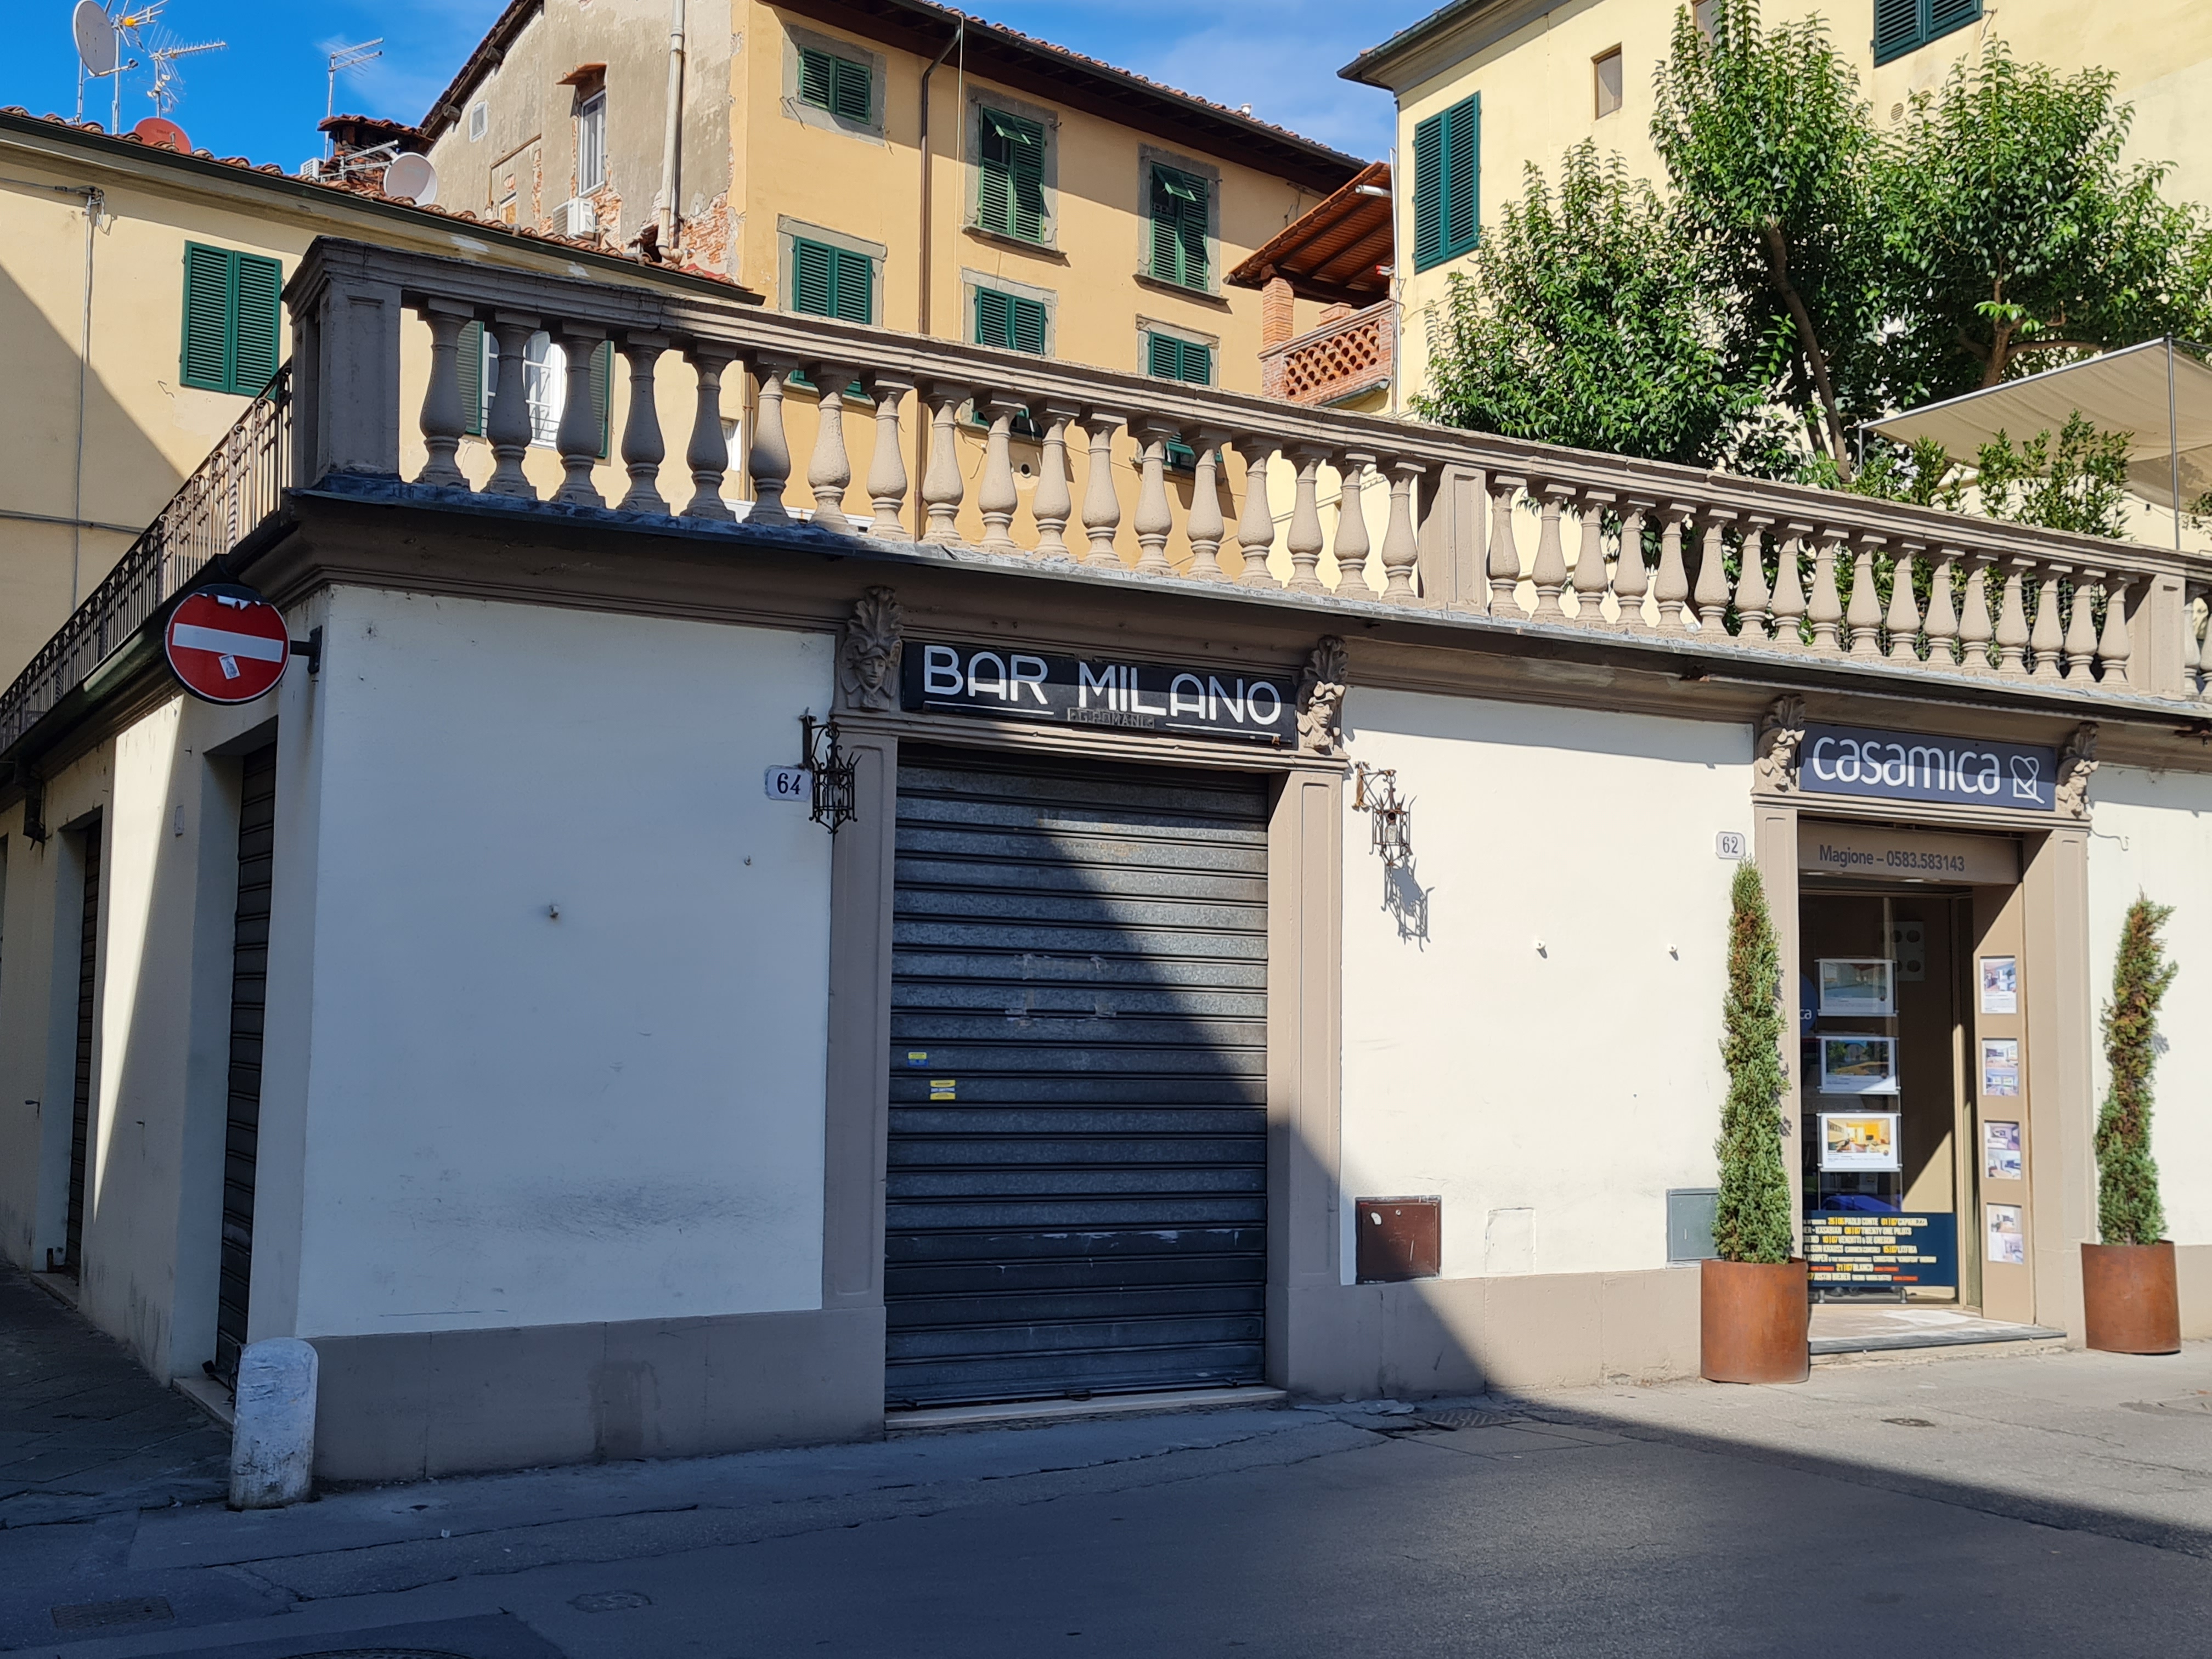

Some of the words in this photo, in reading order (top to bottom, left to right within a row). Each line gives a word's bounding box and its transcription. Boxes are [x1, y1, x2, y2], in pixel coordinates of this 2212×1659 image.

[924, 645, 1048, 704] BAR
[1079, 661, 1281, 725] MILANO
[1812, 737, 2001, 795] casamica
[777, 772, 801, 795] 64
[1723, 836, 1738, 854] 62
[1819, 844, 1874, 867] Magione
[1887, 850, 1965, 872] 0583.583143
